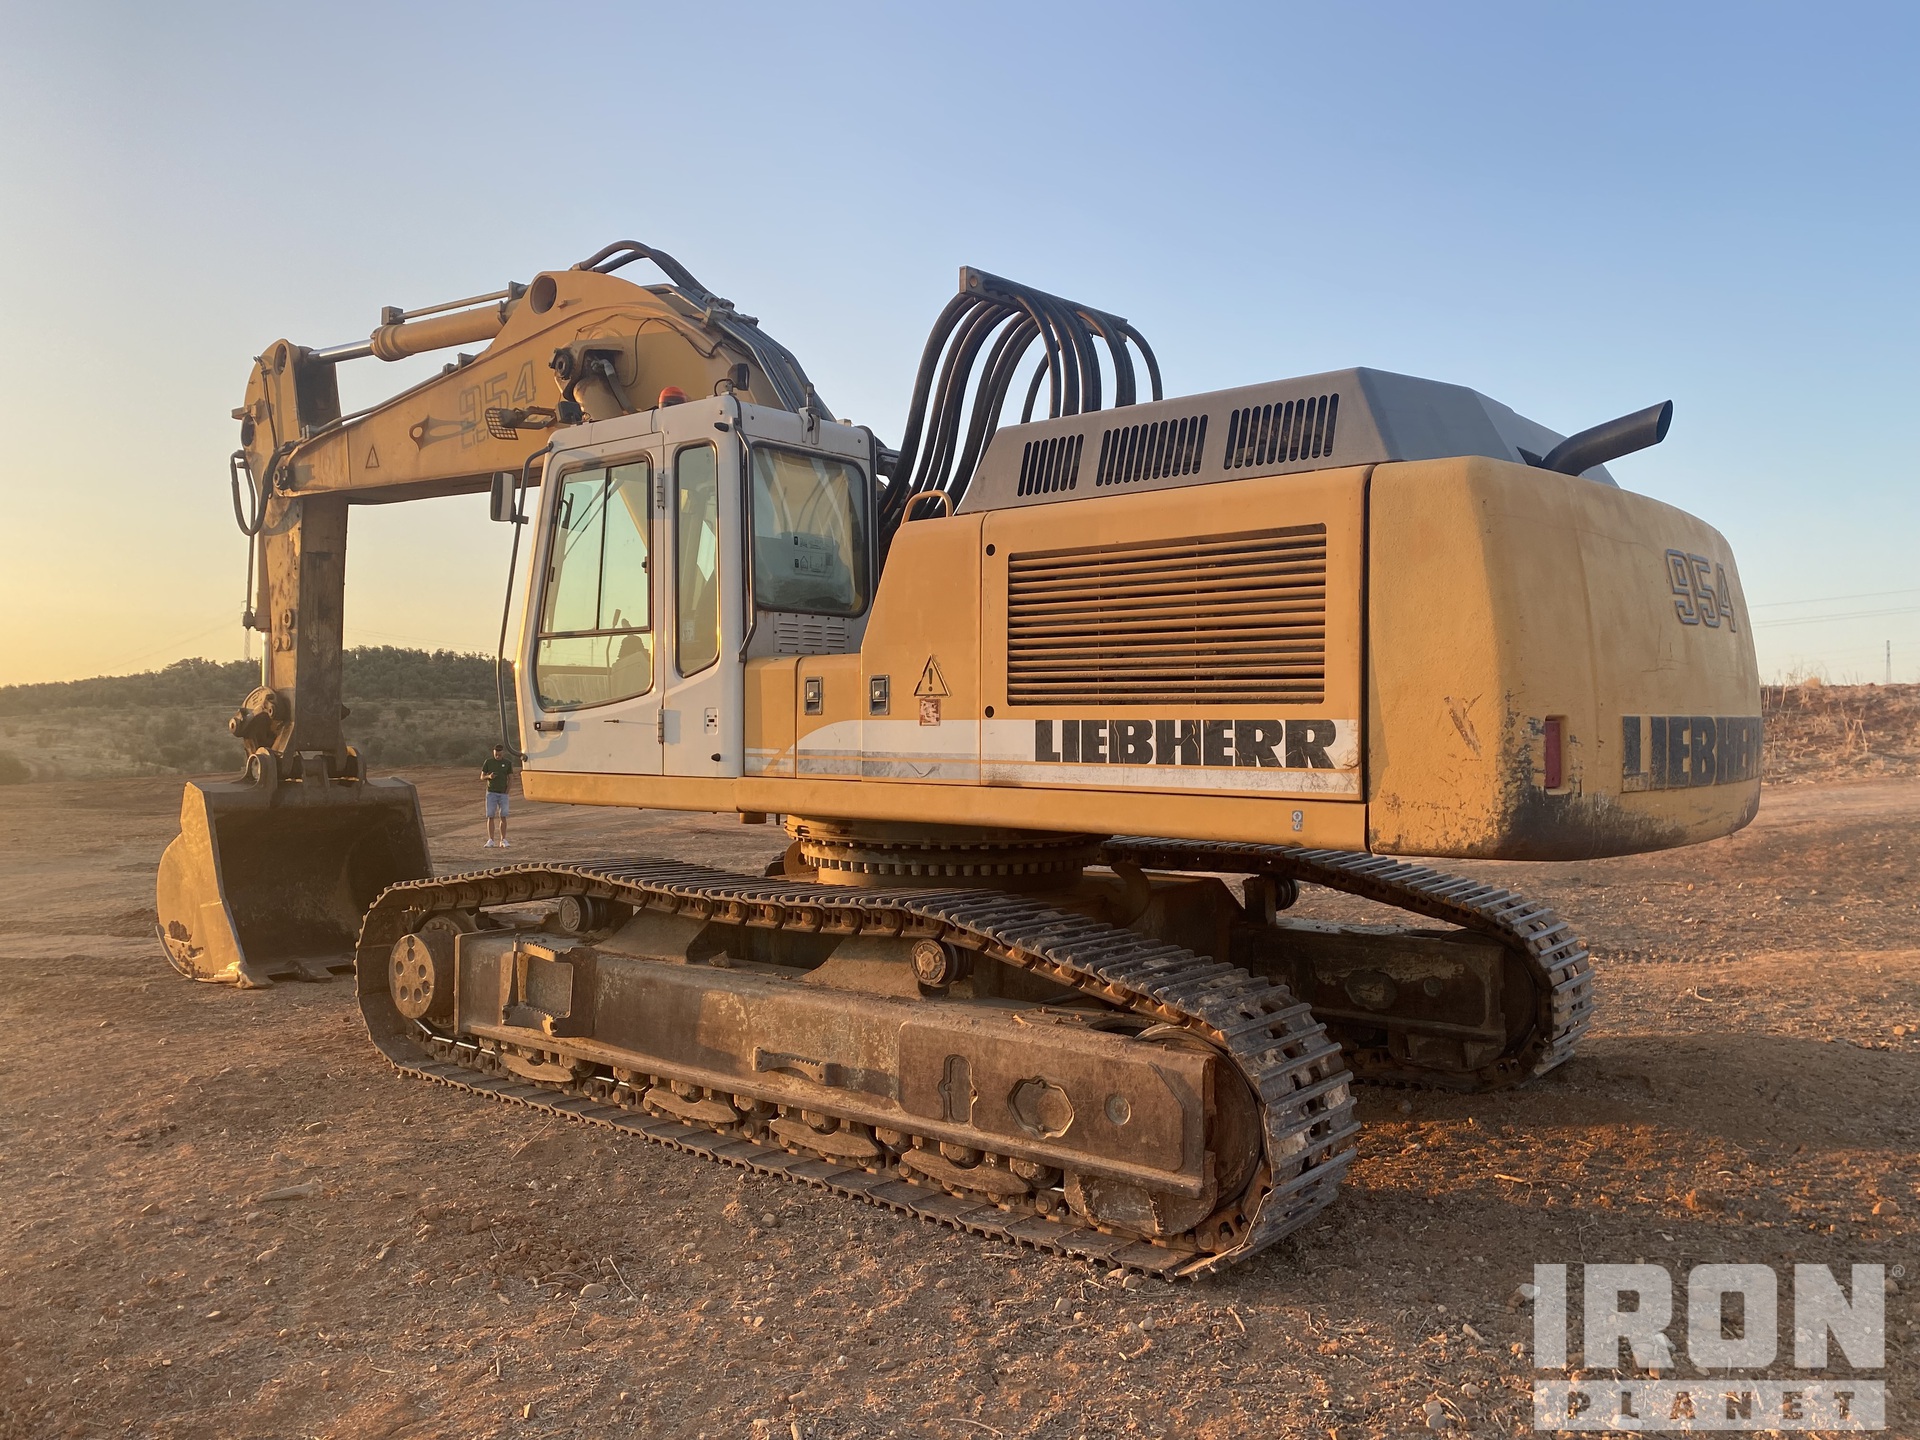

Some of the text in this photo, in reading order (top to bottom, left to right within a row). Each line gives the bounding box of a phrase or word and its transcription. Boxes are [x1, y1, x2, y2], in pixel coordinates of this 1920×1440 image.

[459, 360, 537, 428] 954
[1665, 549, 1737, 633] 954
[1035, 719, 1337, 769] LIEBHERR
